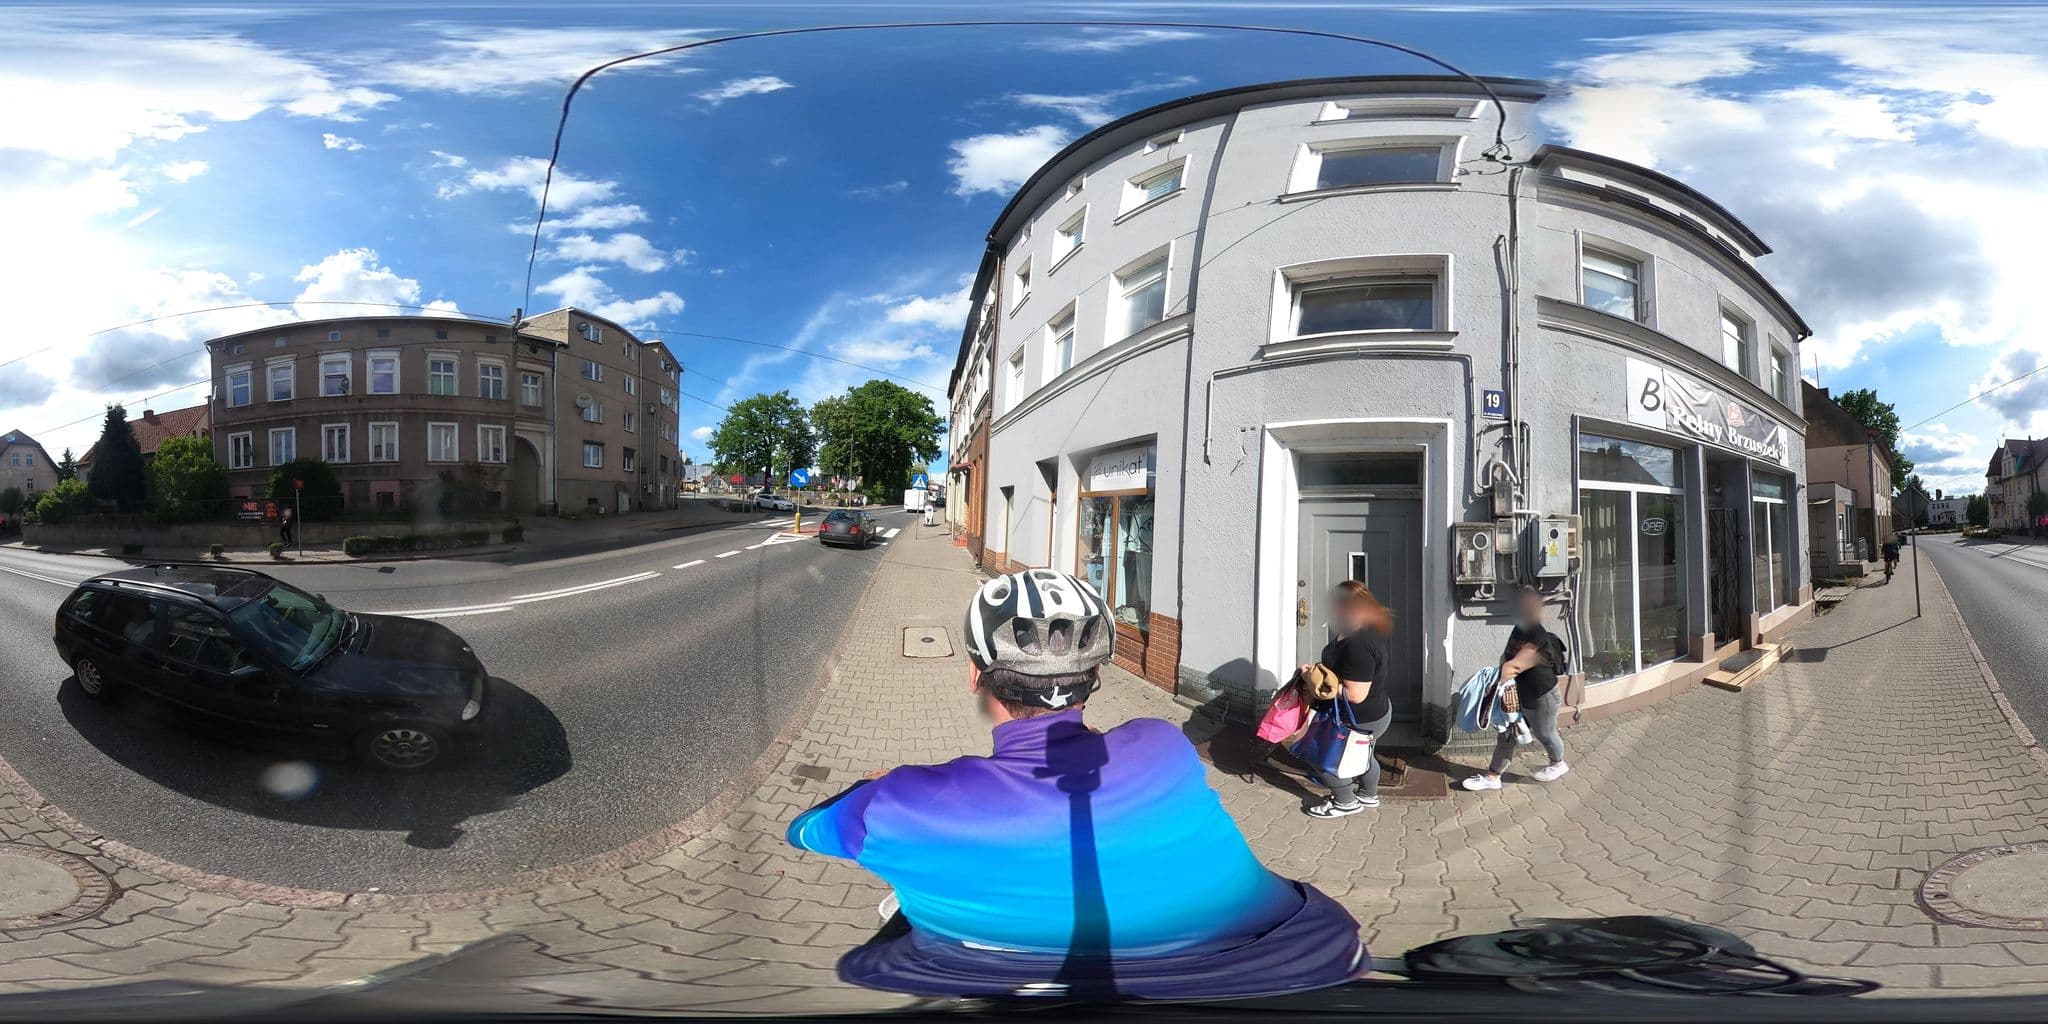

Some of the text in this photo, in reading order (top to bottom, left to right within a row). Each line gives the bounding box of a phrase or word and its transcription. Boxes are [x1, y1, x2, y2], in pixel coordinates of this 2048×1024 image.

[1486, 393, 1500, 408] 19
[1728, 426, 1780, 460] Brzuszek
[1103, 455, 1142, 480] unikat
